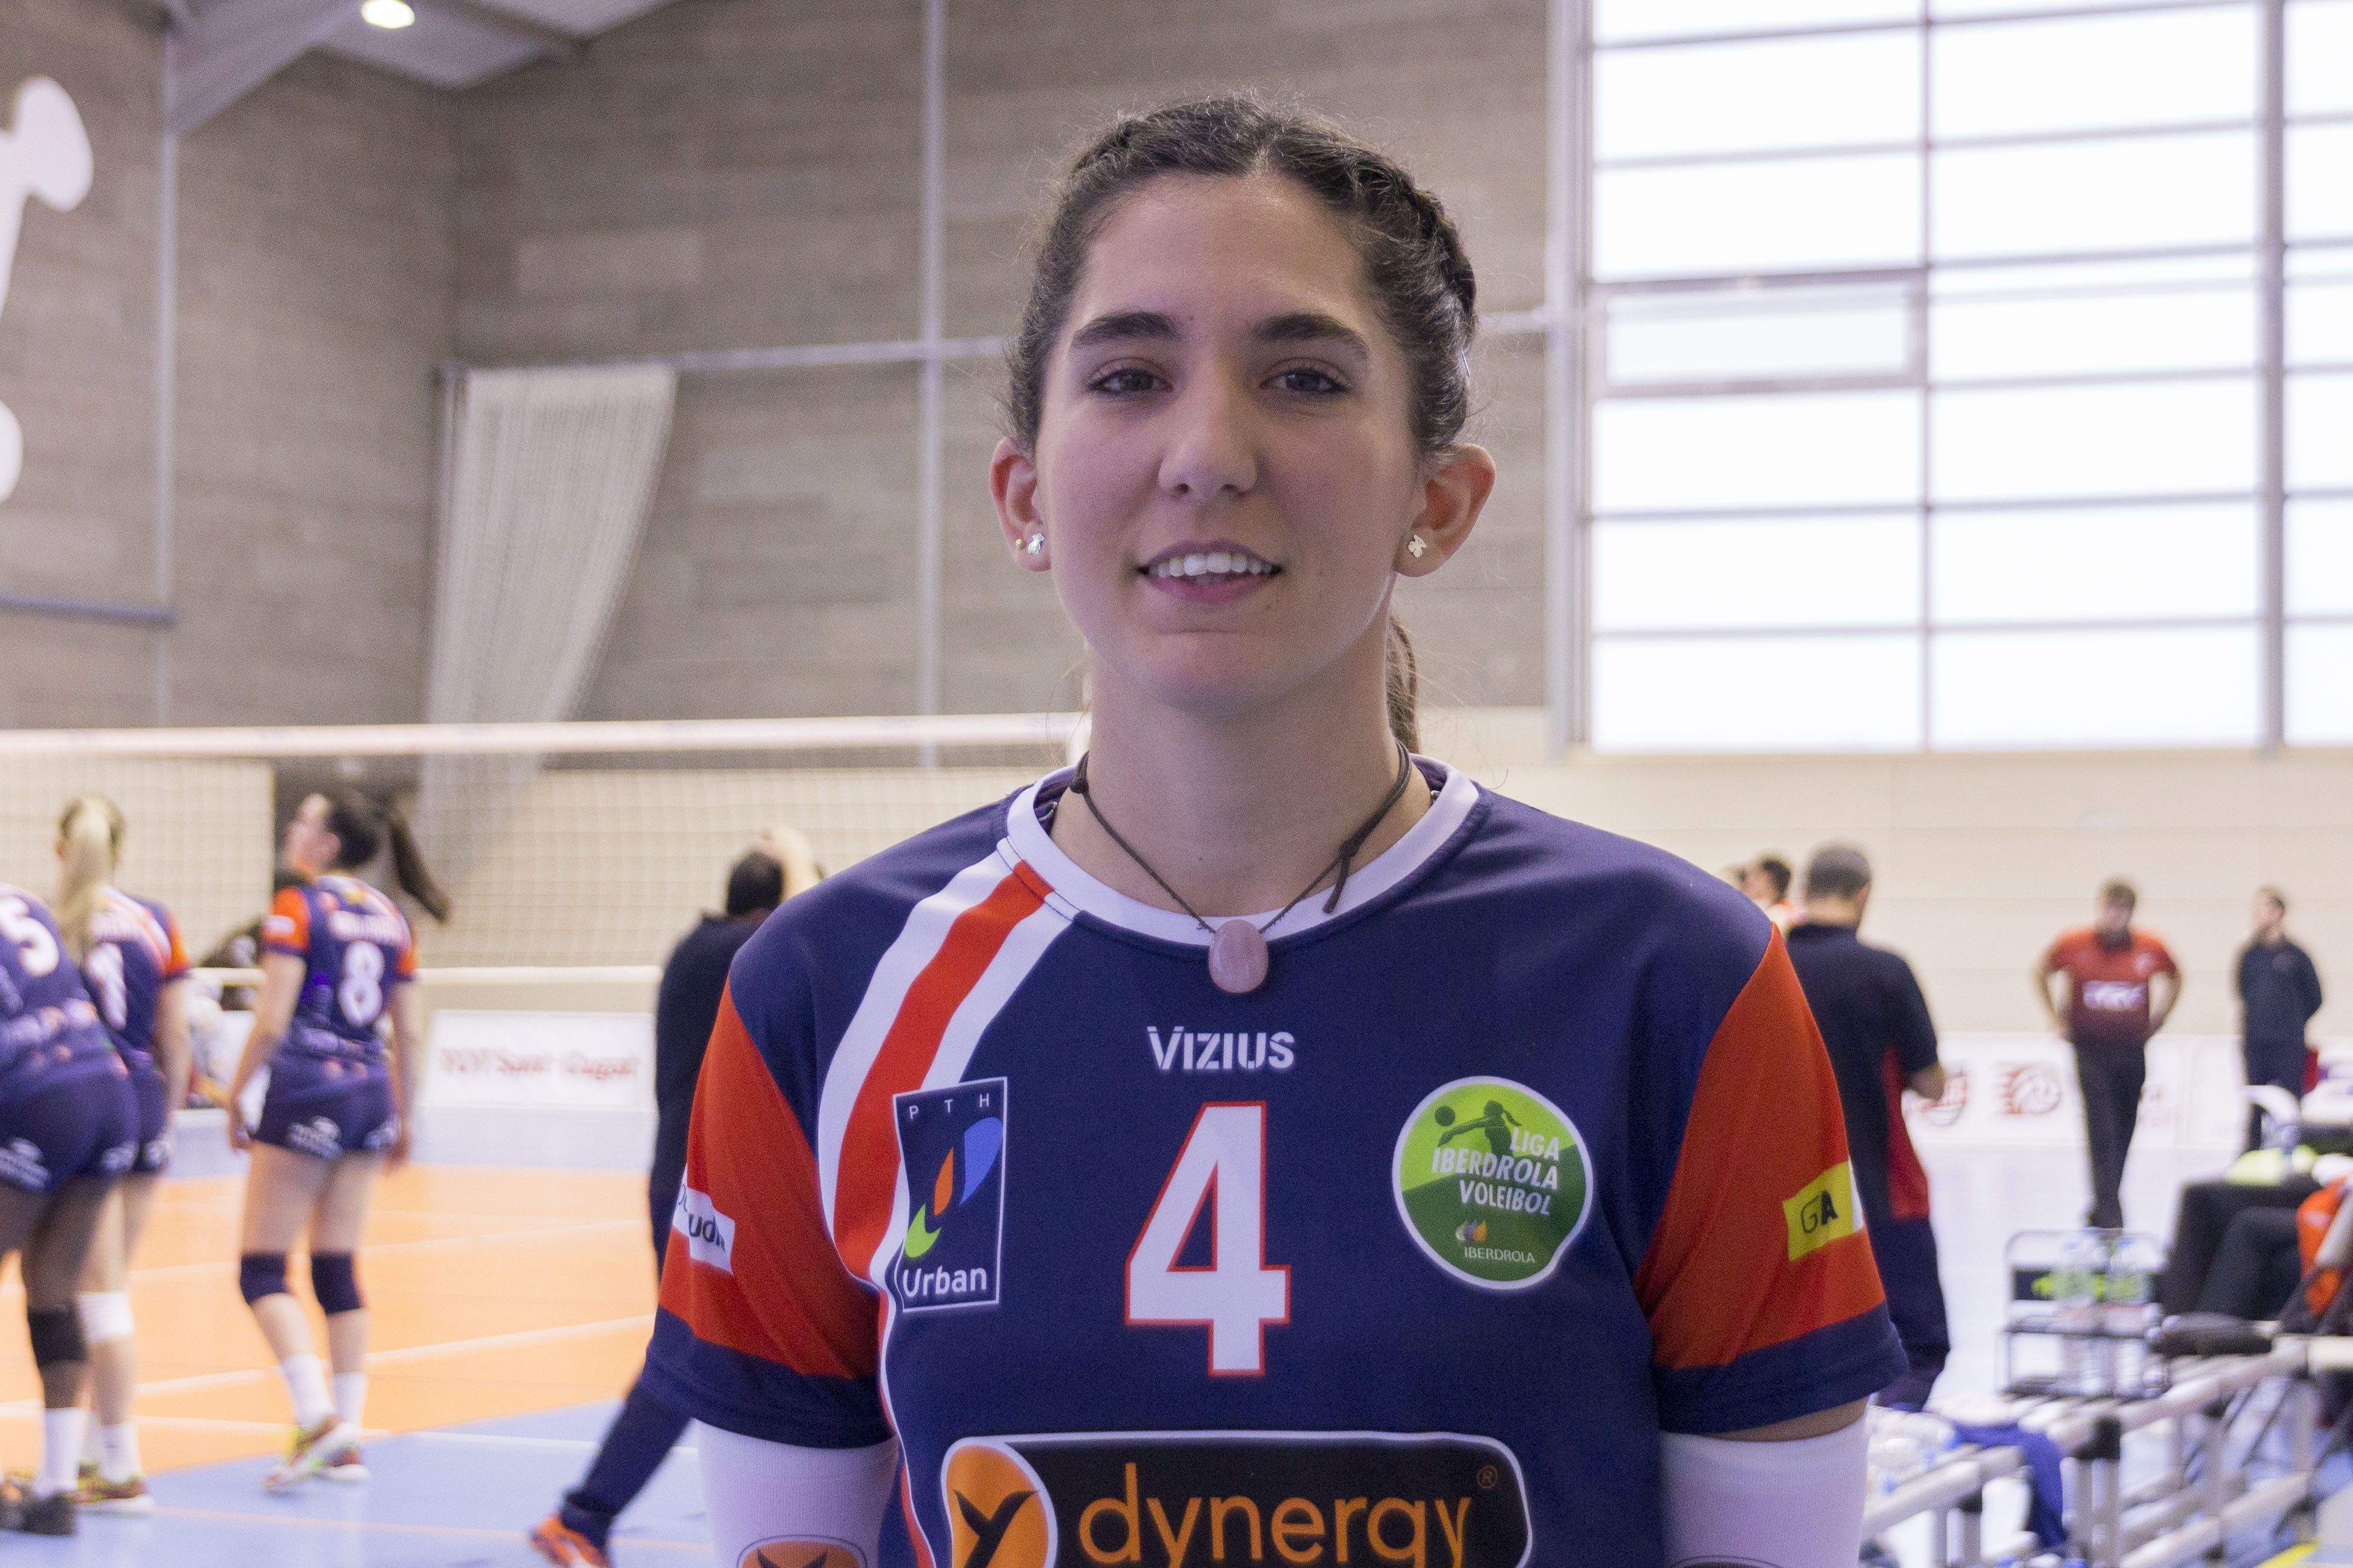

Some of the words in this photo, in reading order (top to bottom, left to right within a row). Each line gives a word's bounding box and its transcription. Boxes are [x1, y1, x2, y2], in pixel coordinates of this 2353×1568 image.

[339, 941, 385, 1027] 8
[1147, 1025, 1295, 1070] VIZIUS
[1509, 1126, 1560, 1162] LIGA
[1432, 1148, 1559, 1191] IBERDROLA
[1459, 1179, 1552, 1216] VOLEIBOL
[1800, 1189, 1839, 1234] GA
[1124, 1100, 1291, 1376] 4
[1464, 1246, 1536, 1264] IBERDROLA
[902, 1265, 987, 1298] Urban
[1078, 1462, 1472, 1568] dynergy
